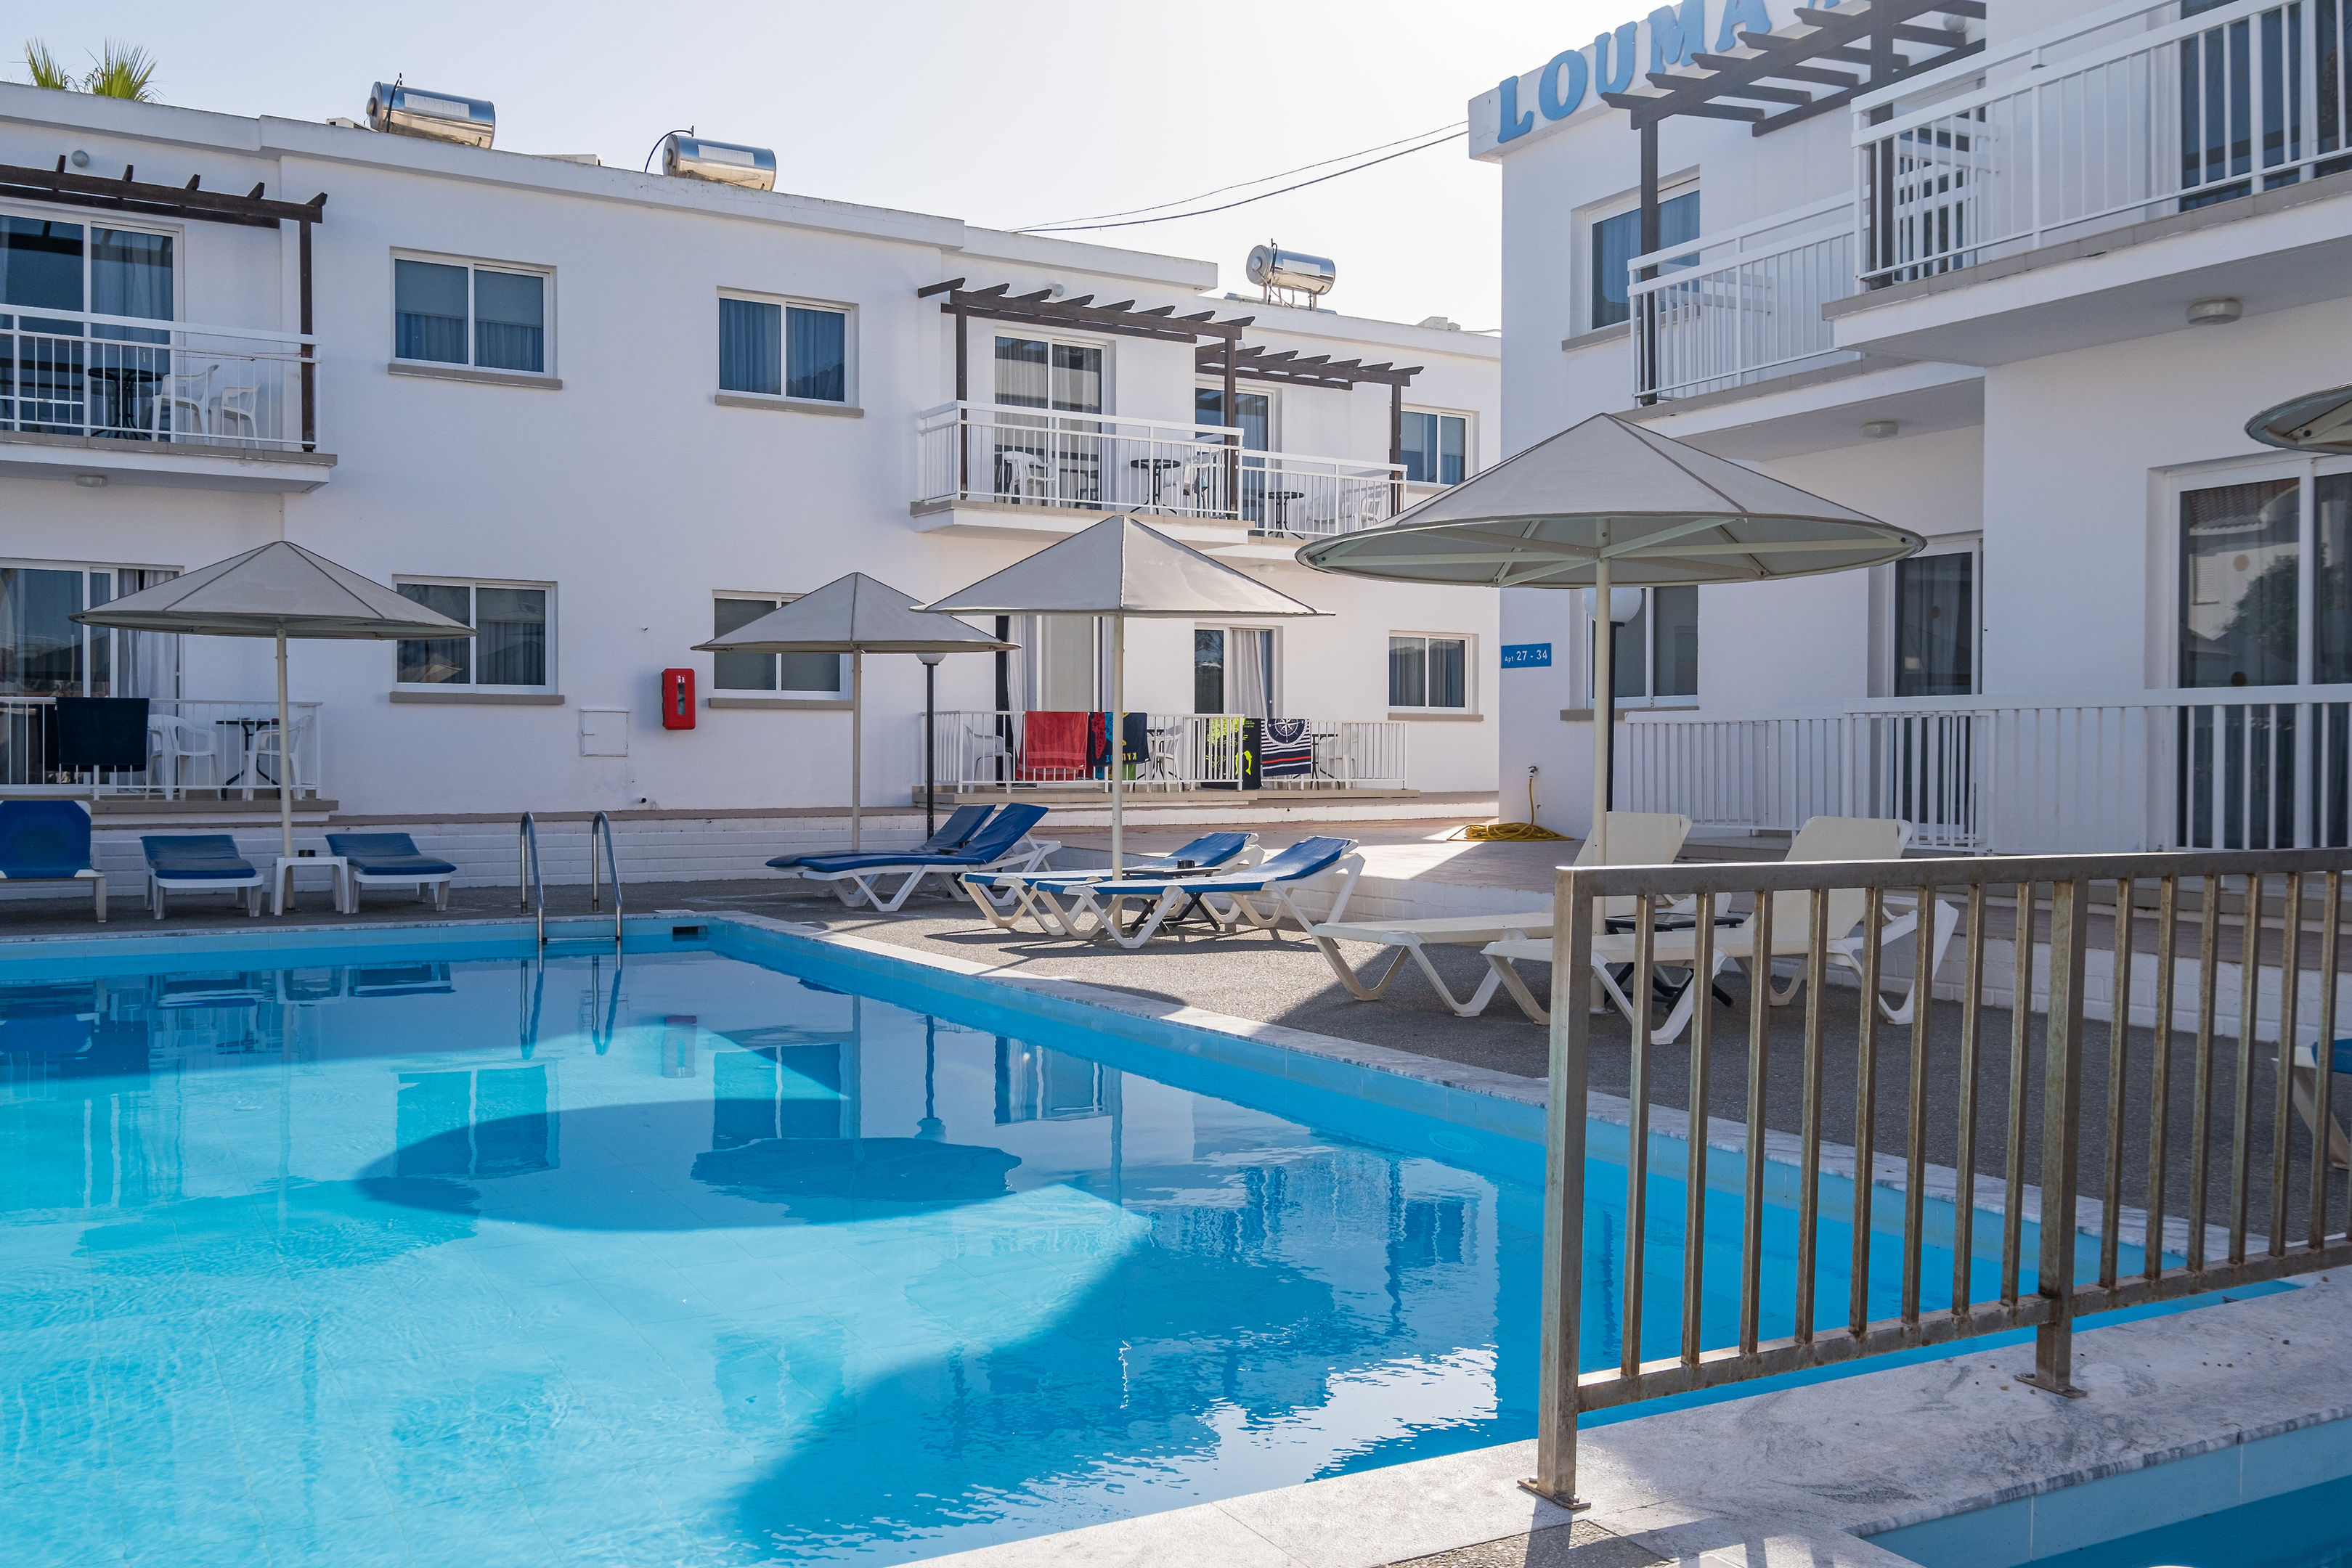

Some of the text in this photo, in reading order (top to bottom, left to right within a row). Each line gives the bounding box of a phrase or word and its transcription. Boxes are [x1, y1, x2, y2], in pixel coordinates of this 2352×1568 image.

[1497, 0, 1773, 144] LOUMA
[1516, 650, 1528, 661] 27
[1536, 650, 1548, 660] 34
